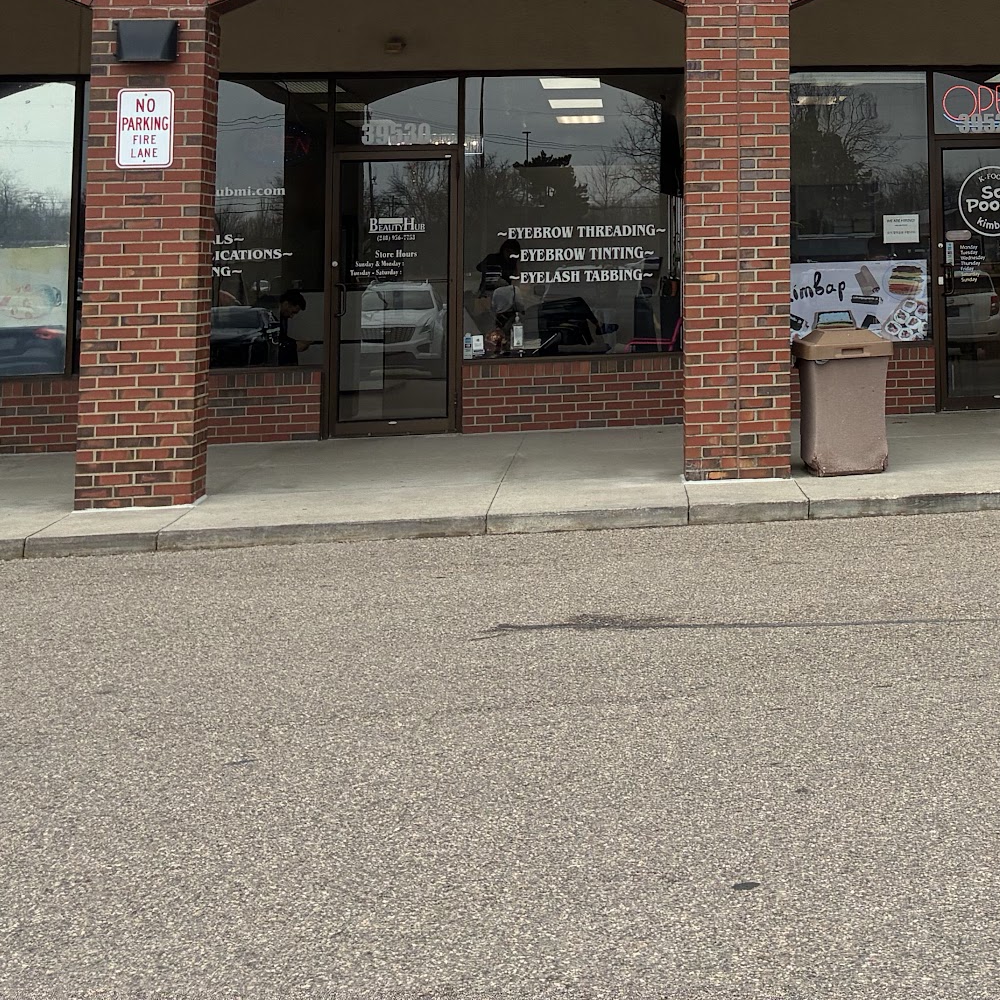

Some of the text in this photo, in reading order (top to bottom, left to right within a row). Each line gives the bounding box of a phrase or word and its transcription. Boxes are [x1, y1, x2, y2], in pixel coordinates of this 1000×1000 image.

[136, 98, 156, 113] NO
[122, 116, 169, 131] PARKING
[133, 135, 157, 145] FIRE
[362, 122, 431, 146] 39530
[130, 148, 158, 158] LANE
[212, 234, 245, 245] LS~
[211, 249, 293, 261] ICATIONS~
[375, 250, 418, 258] Store Hours
[790, 271, 846, 302] imbap
